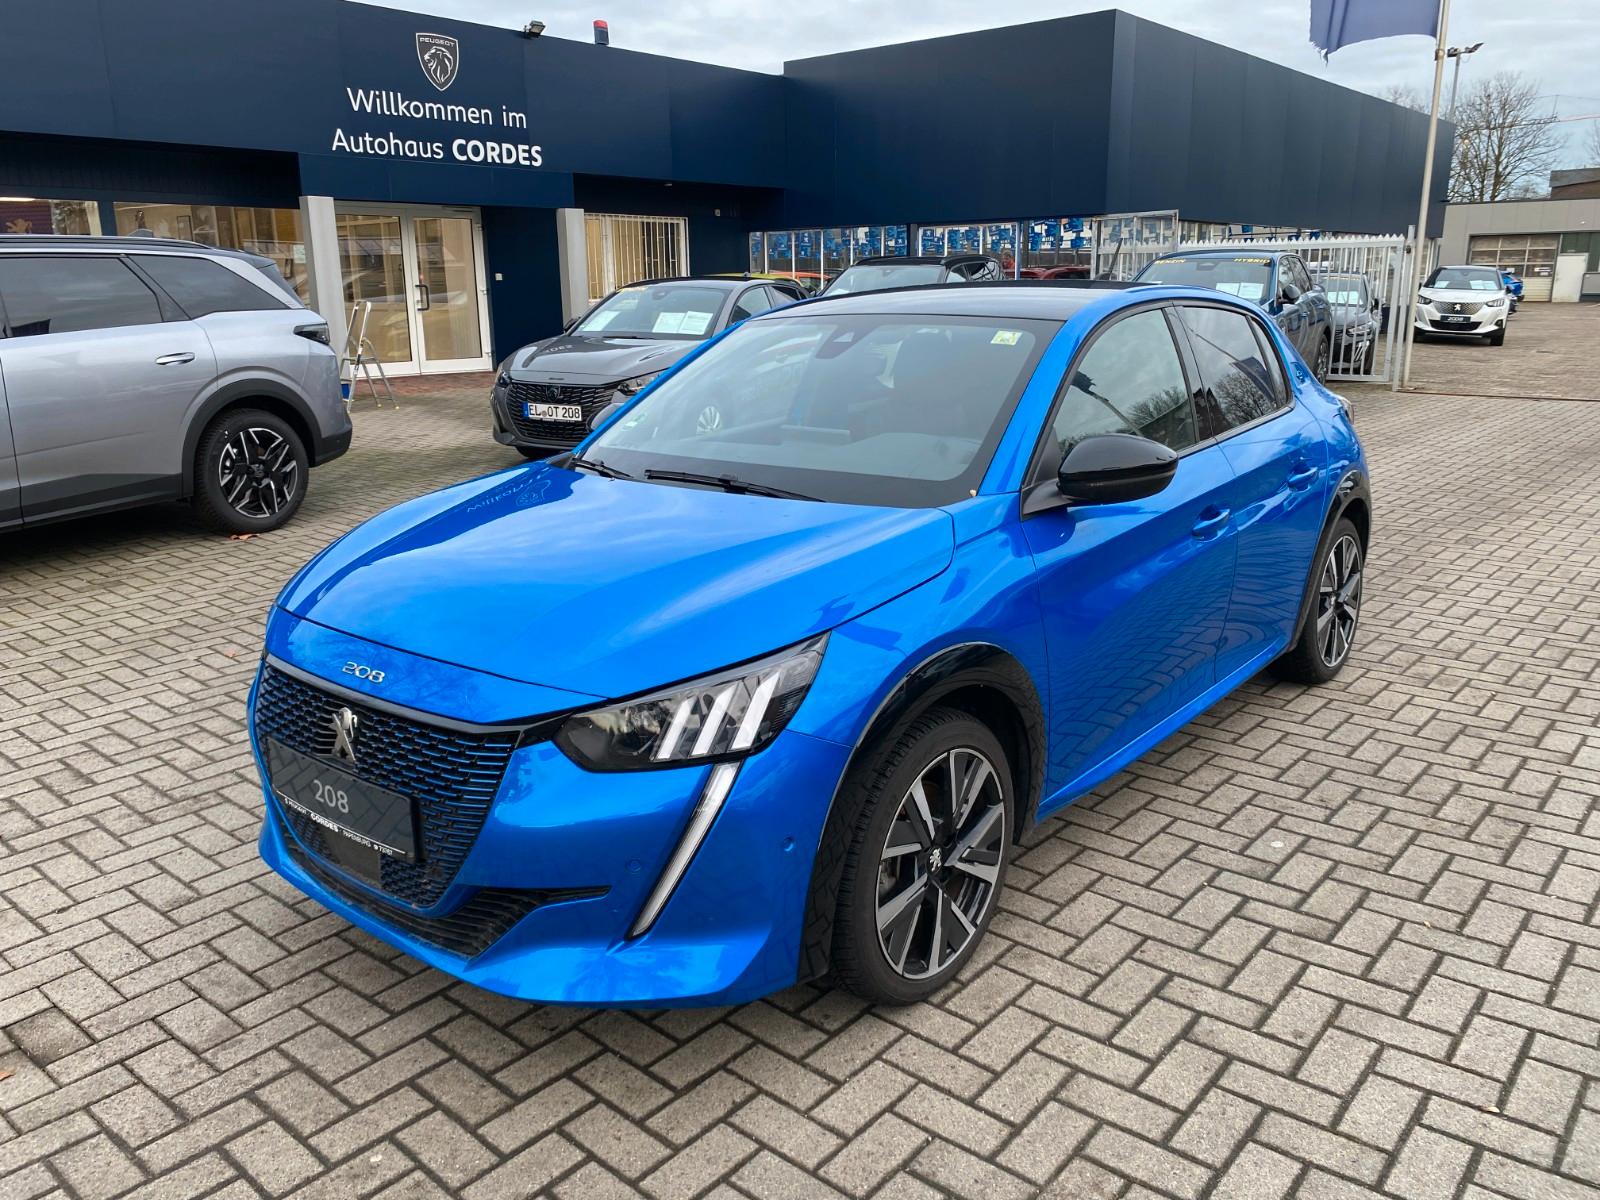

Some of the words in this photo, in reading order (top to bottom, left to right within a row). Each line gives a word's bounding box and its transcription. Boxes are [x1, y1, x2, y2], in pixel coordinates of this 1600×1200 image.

[419, 37, 455, 47] PEUGEOT
[346, 87, 492, 125] Willkommen
[502, 105, 527, 129] im
[331, 128, 444, 159] Autohaus
[452, 138, 543, 167] CORDES
[528, 404, 541, 416] EL
[547, 406, 559, 418] OT
[562, 407, 581, 419] 208
[342, 661, 386, 683] 208
[313, 779, 349, 813] 208
[310, 813, 339, 832] CORDES
